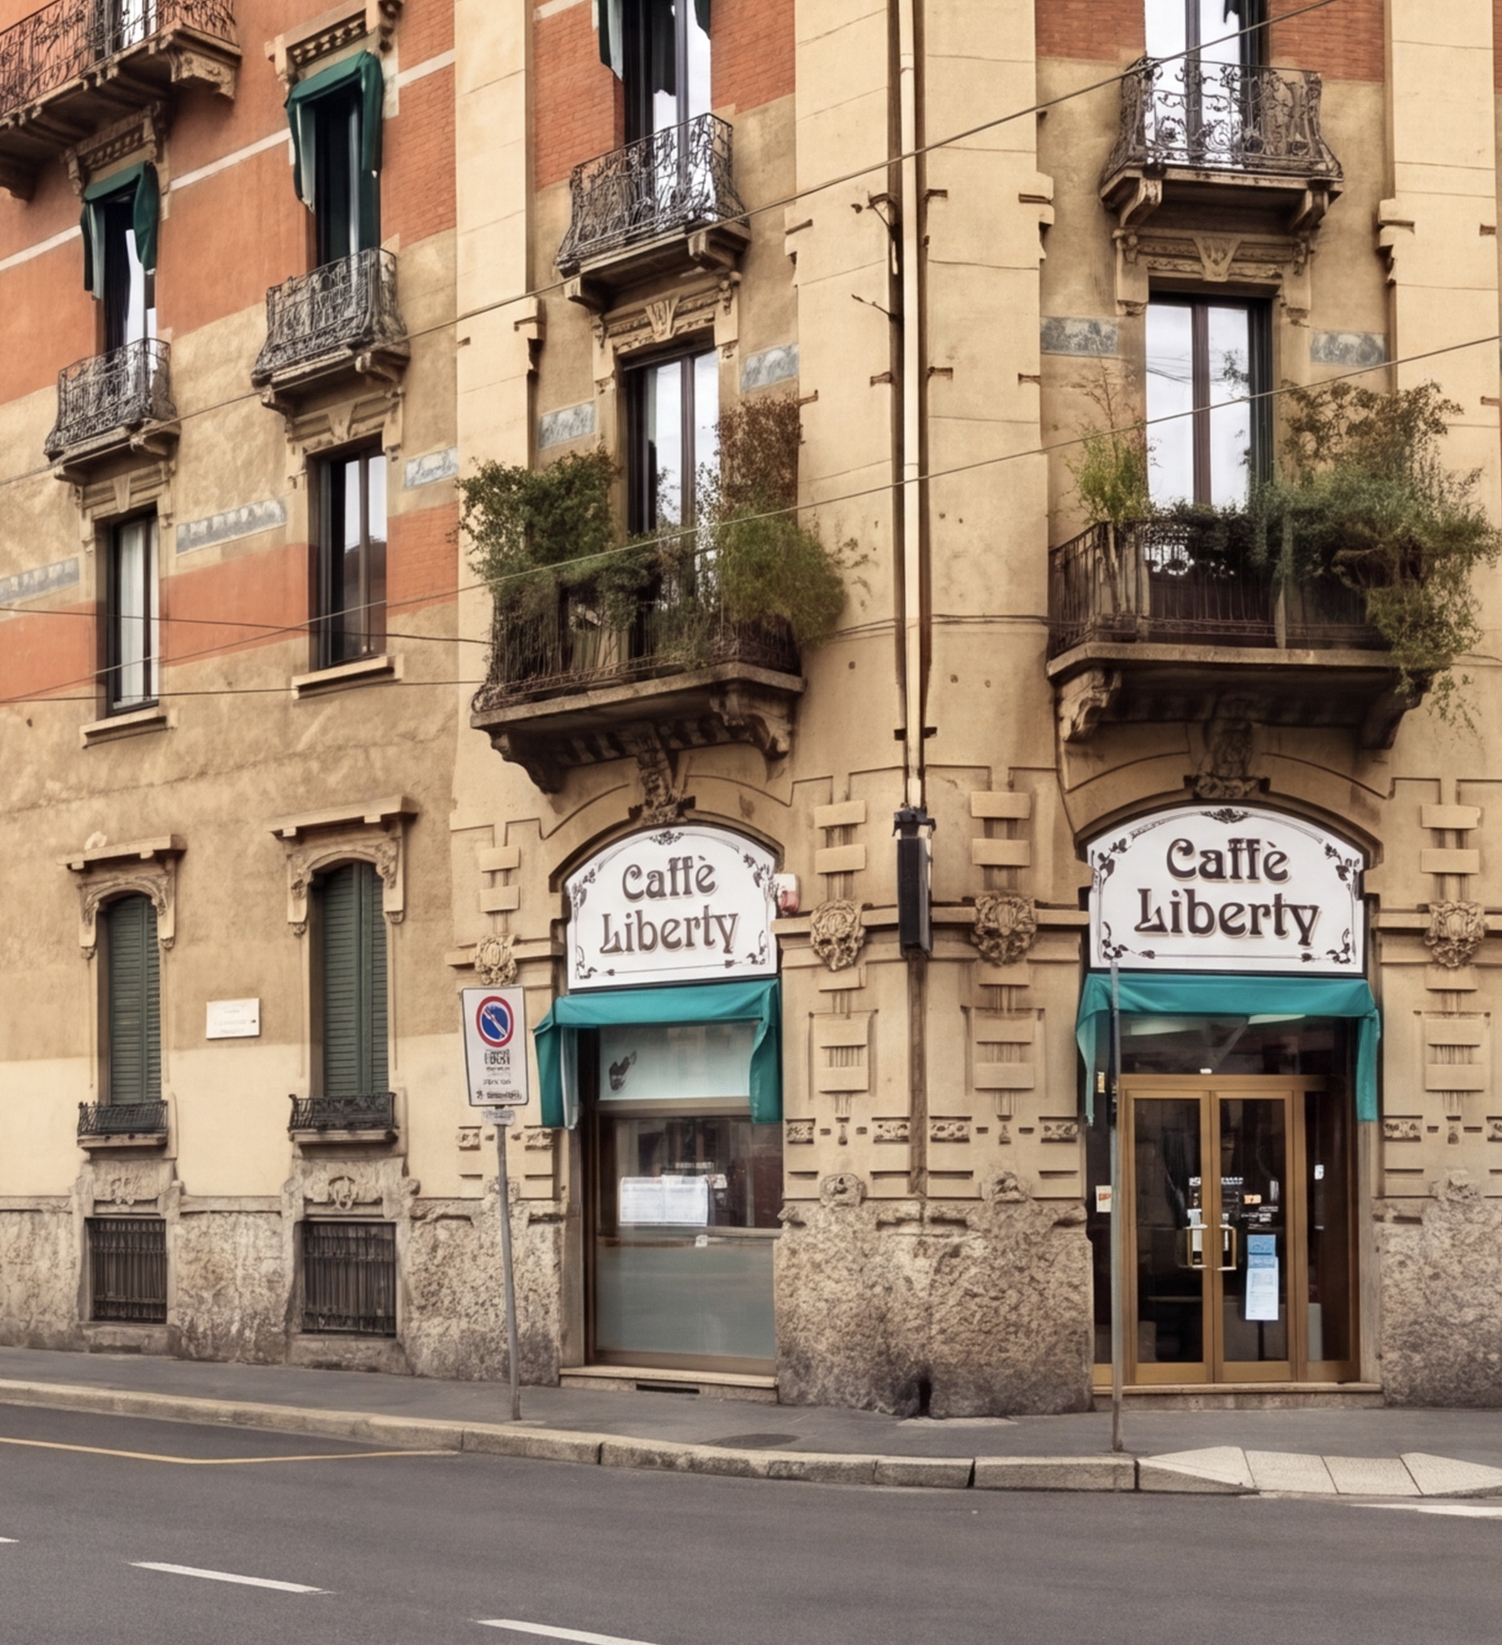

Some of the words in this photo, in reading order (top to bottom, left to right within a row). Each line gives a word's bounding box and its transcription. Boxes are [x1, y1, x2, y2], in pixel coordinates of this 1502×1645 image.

[622, 855, 716, 900] Caffè
[1166, 838, 1290, 882] Caffè
[599, 904, 739, 954] Liberty
[1134, 888, 1320, 947] Liberty
